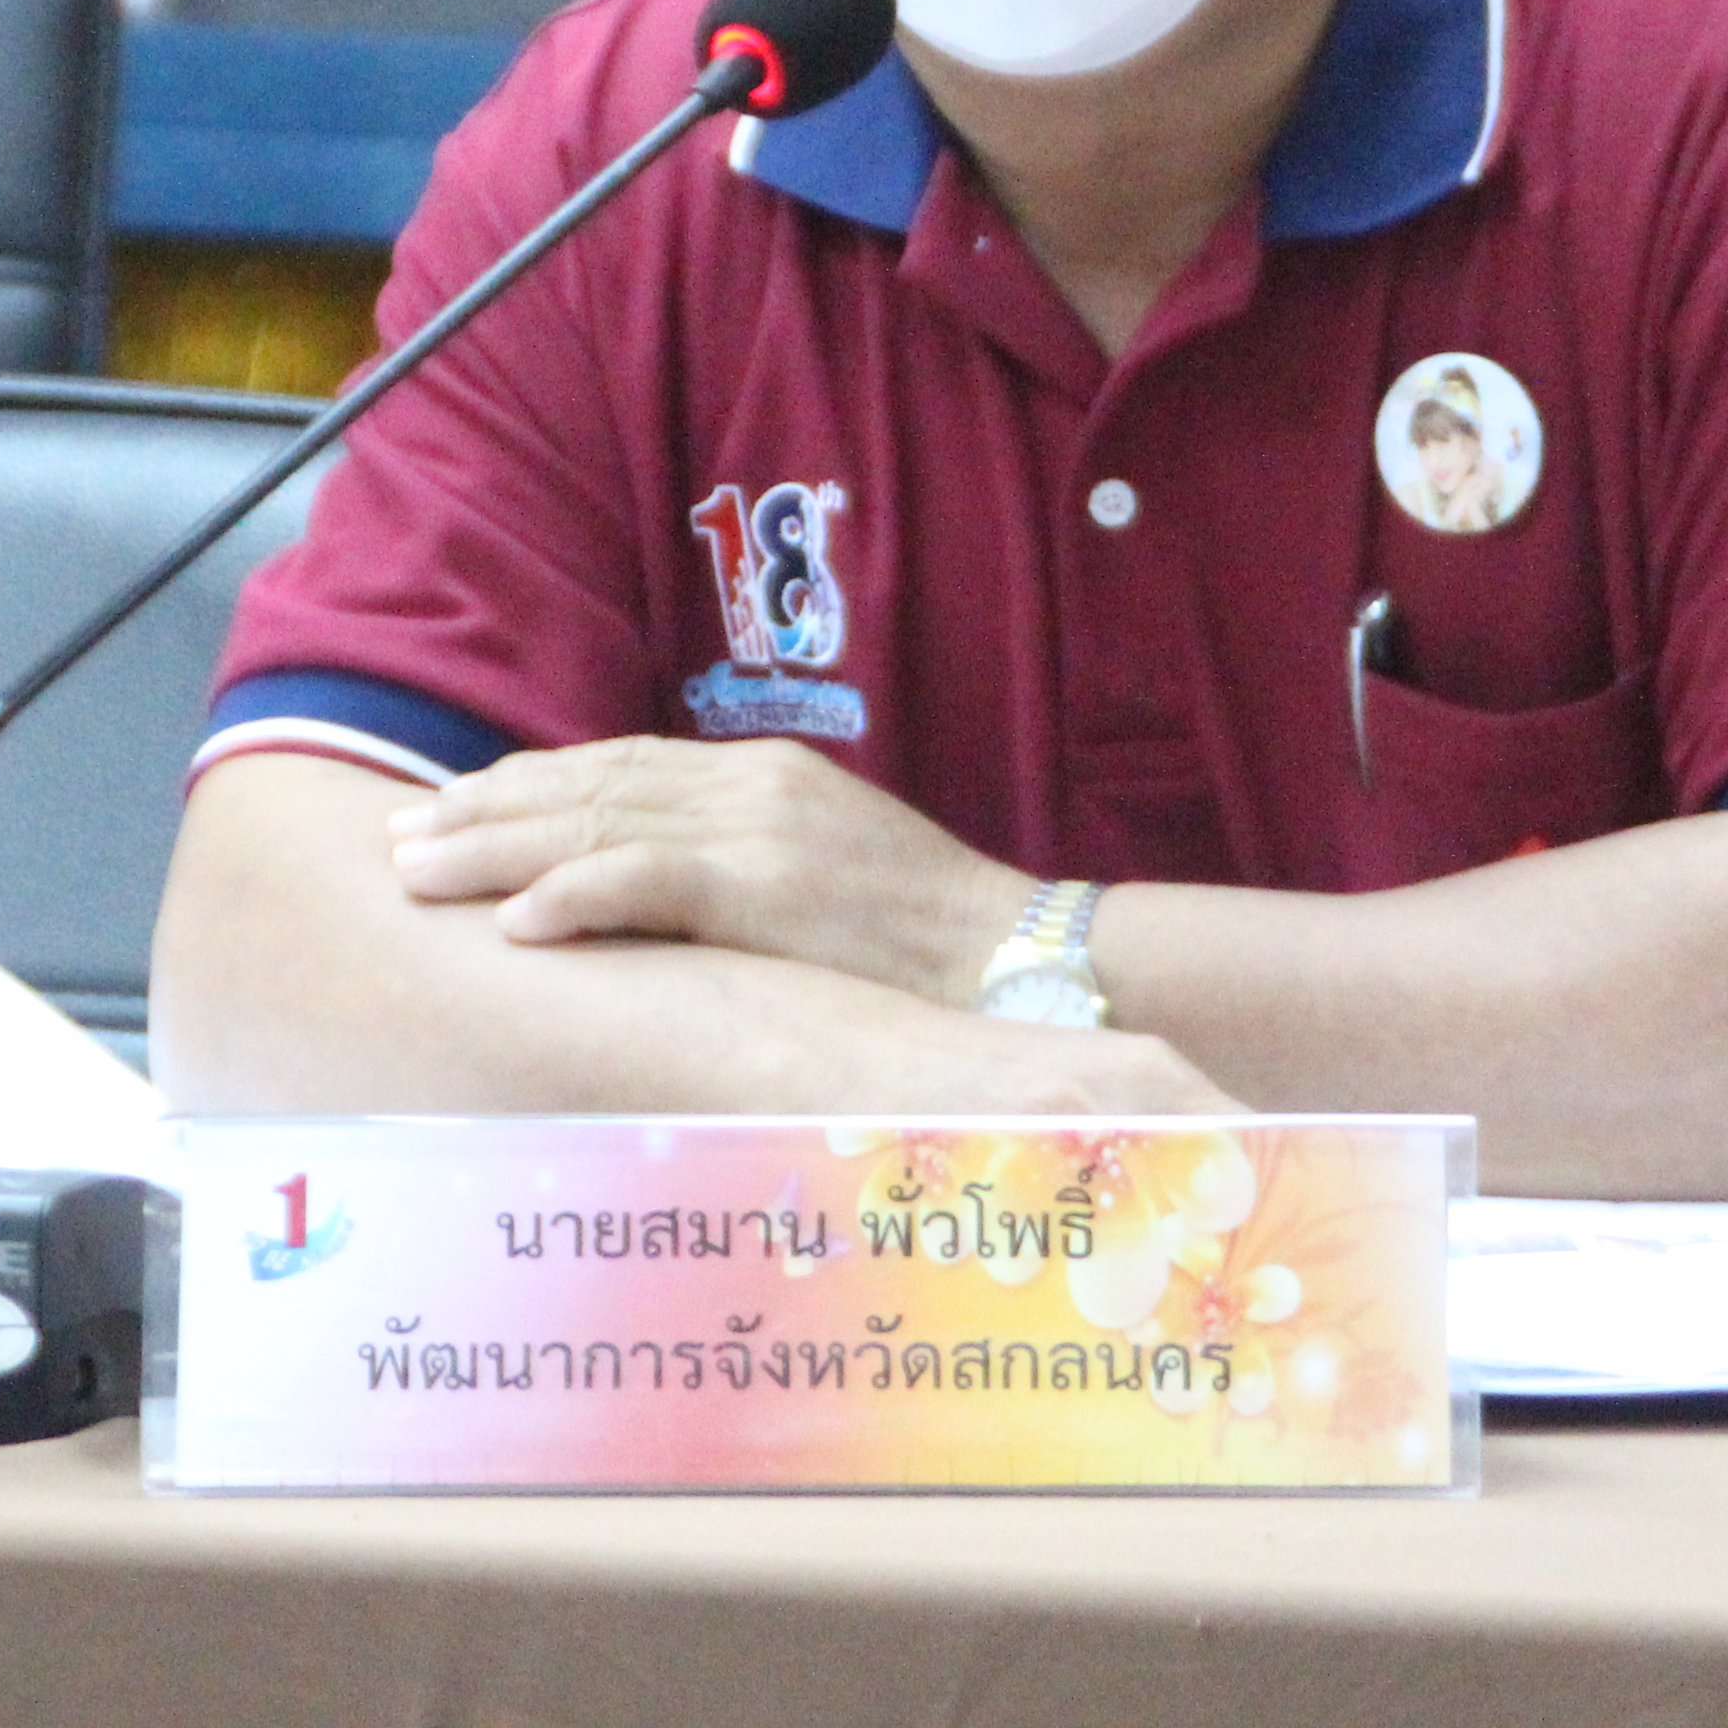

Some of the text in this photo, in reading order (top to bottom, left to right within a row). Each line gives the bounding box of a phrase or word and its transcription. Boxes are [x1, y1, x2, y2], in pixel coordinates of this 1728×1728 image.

[496, 1207, 827, 1259] นายสมาน
[357, 1313, 1235, 1391] พัฒนาการจังหวัดสกลนคร
